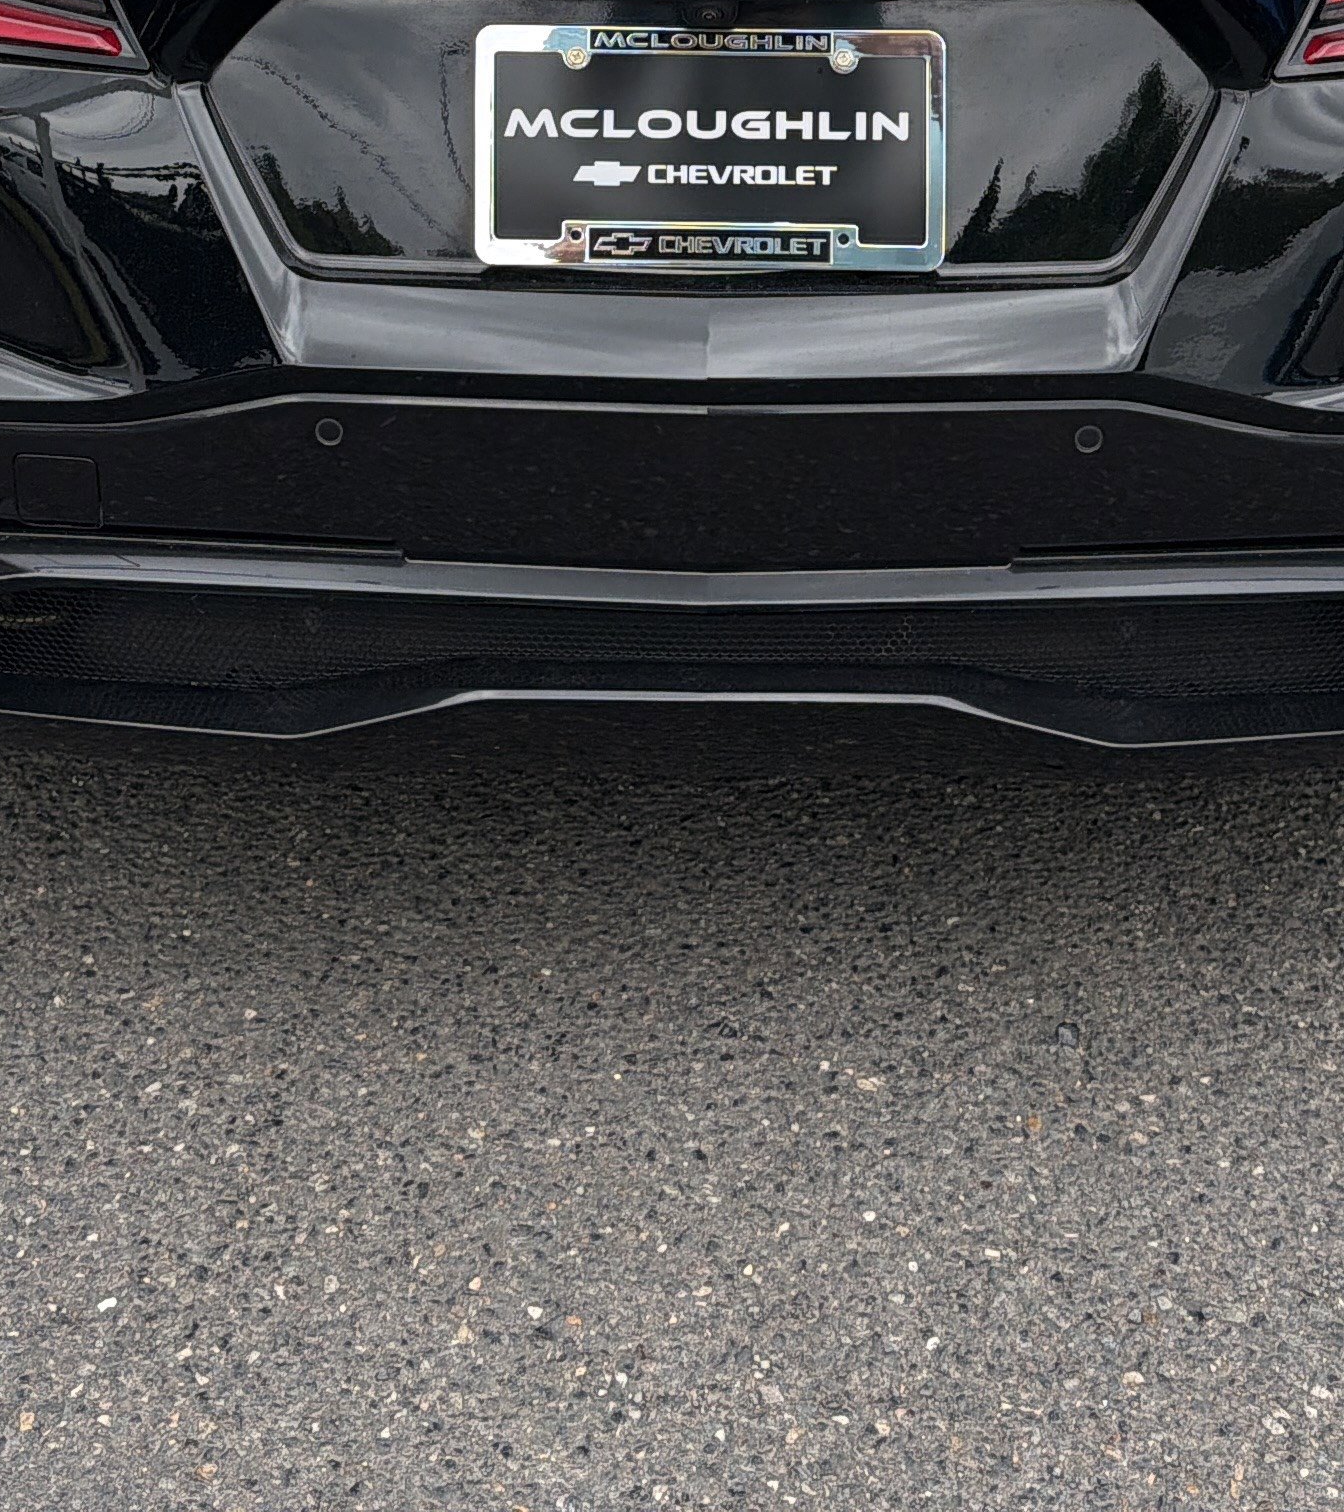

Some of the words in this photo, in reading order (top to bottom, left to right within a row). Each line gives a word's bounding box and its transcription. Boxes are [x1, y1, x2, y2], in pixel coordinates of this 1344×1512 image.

[593, 31, 830, 52] MCLOUGHLIN
[503, 108, 910, 141] MCLOUGHLIN
[647, 164, 837, 186] CHEVROLET
[658, 234, 827, 257] CHEVROLET
